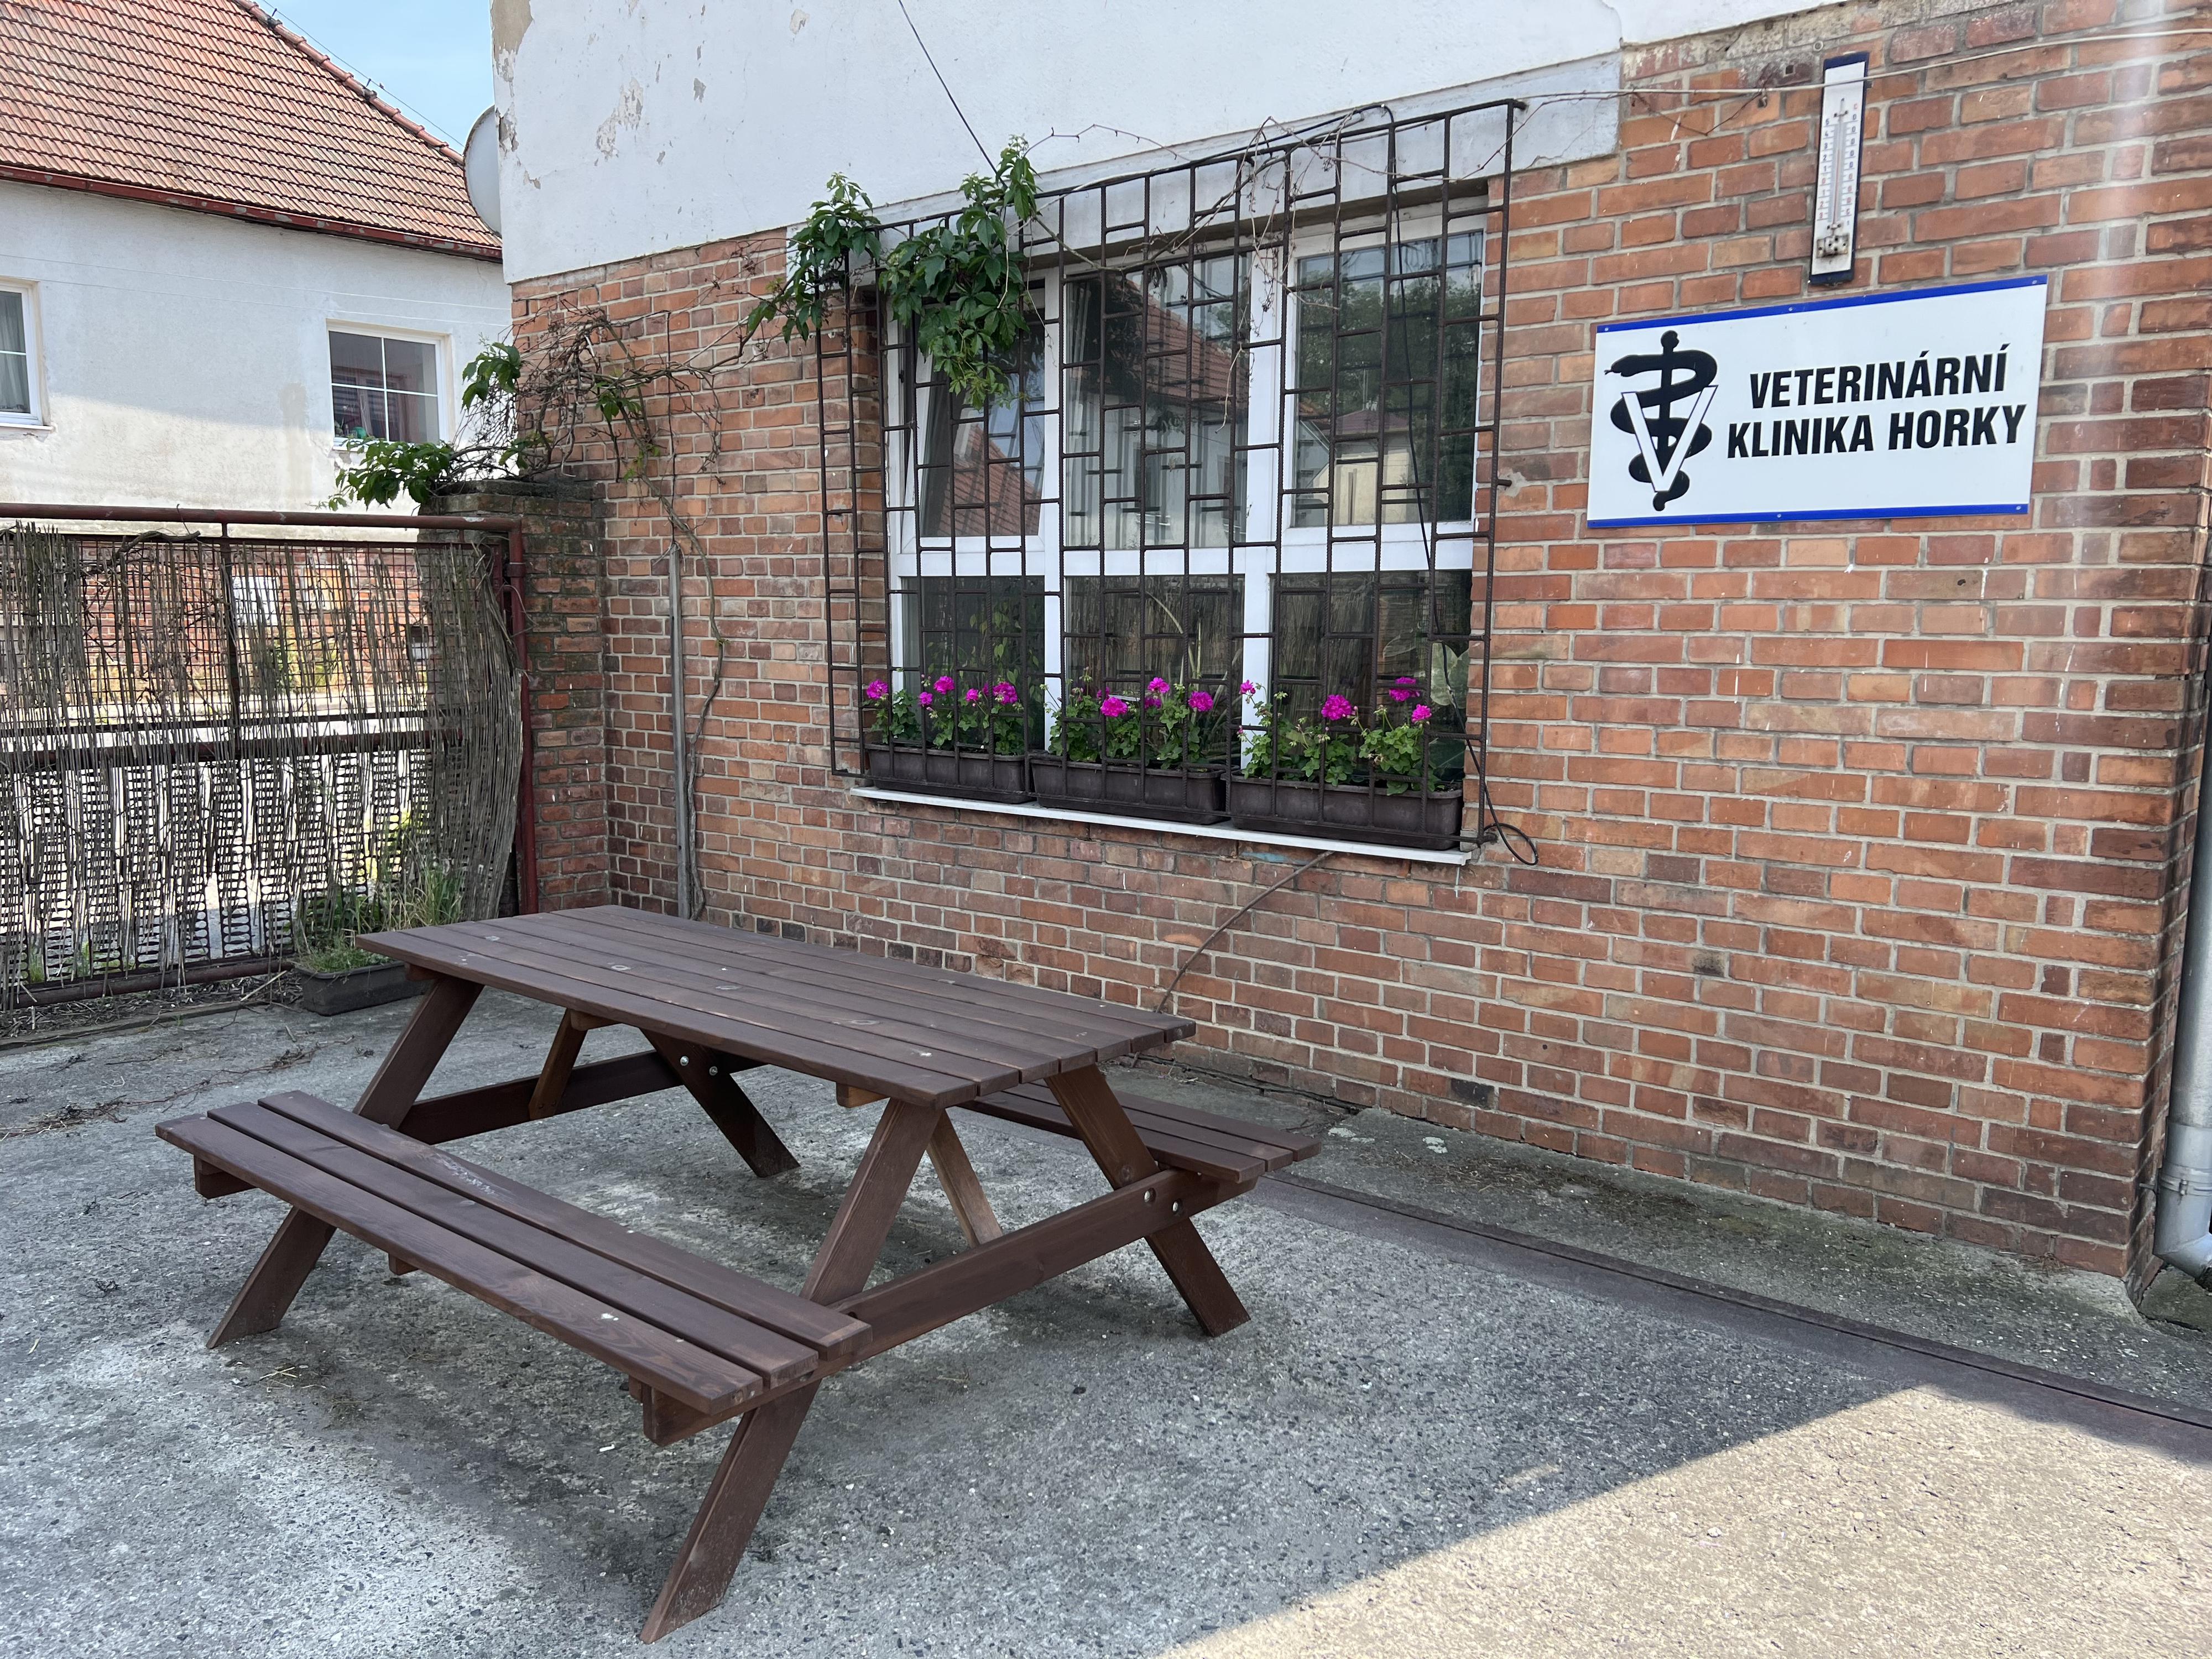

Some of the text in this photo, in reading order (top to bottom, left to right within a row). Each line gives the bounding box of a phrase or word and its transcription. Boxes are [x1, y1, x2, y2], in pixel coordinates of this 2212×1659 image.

[1750, 343, 2010, 409] VETERINÁRNÍ
[1727, 404, 2027, 458] KLINIKA HORKY
